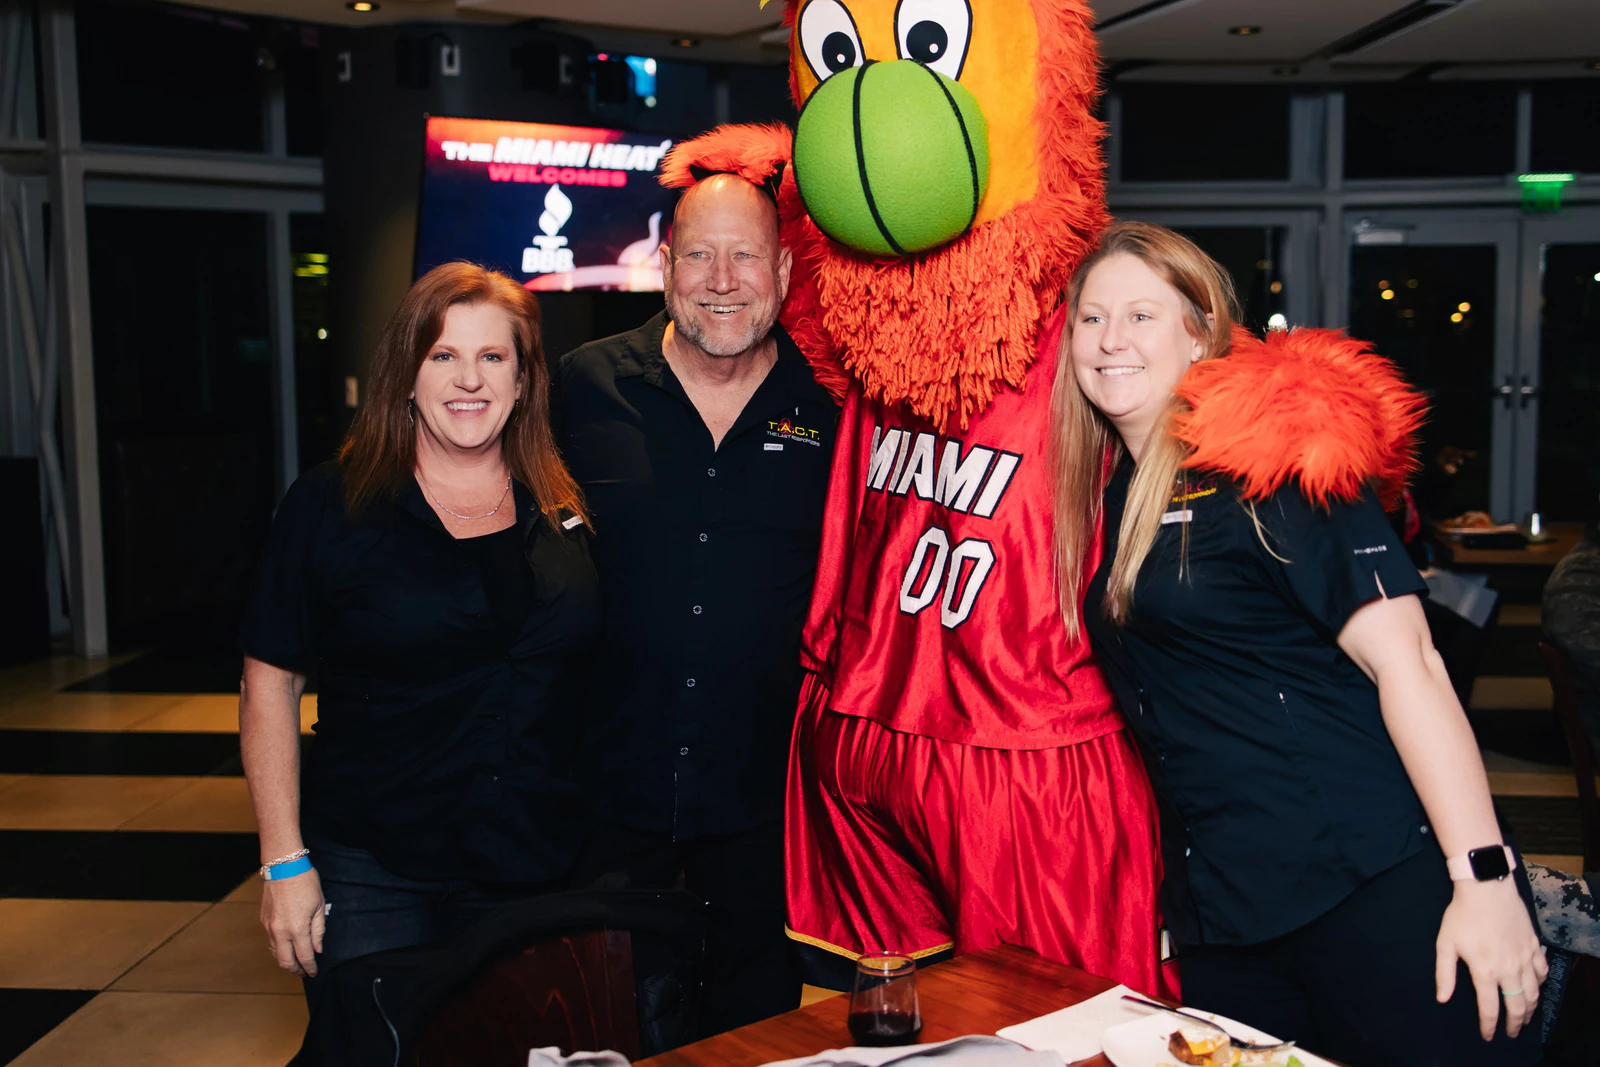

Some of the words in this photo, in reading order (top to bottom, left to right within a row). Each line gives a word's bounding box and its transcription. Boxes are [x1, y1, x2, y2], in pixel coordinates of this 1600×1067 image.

[442, 140, 494, 162] THE
[493, 137, 592, 168] MIAMI
[589, 142, 665, 171] HEAT
[488, 164, 628, 188] WELCOMES
[522, 247, 575, 273] BBB
[768, 421, 820, 440] T.A.C.T.
[866, 425, 1023, 519] MIAMI
[899, 523, 997, 631] 00
